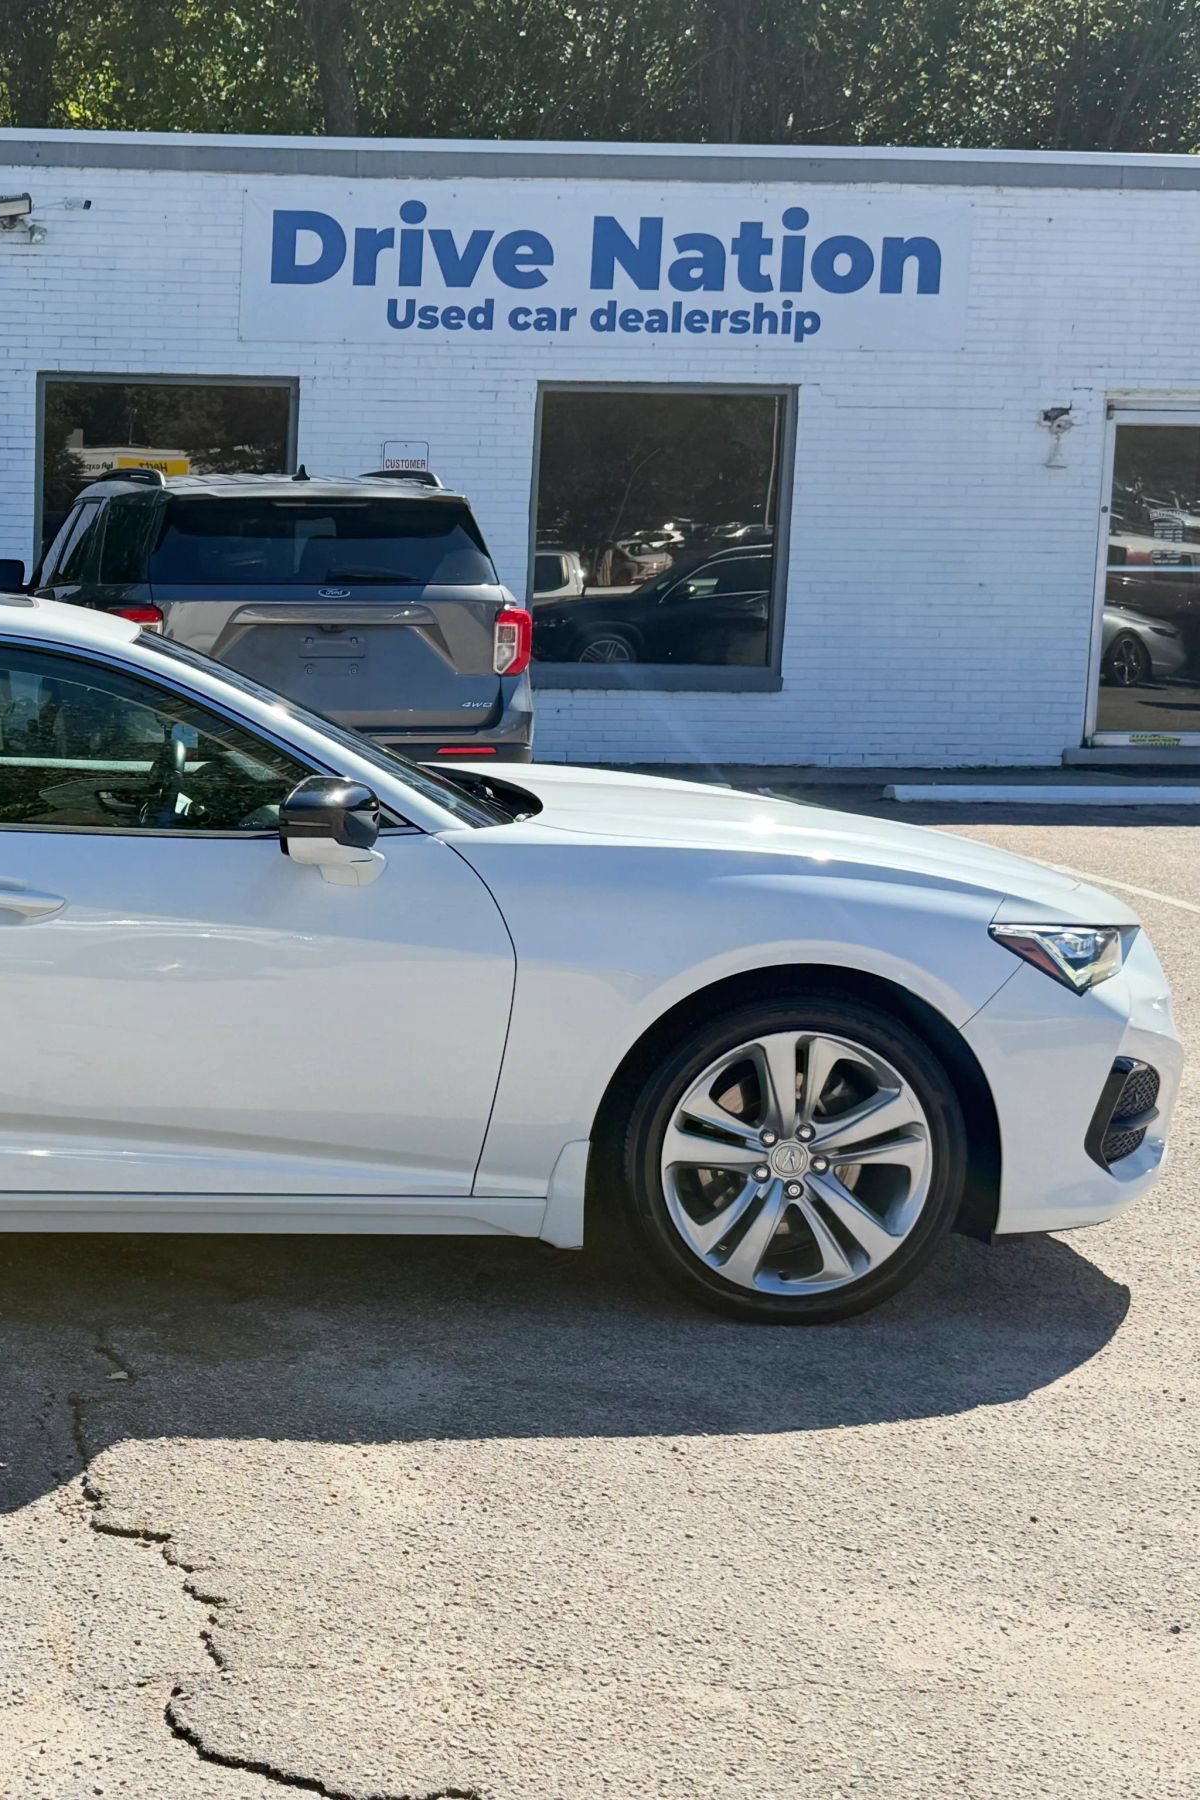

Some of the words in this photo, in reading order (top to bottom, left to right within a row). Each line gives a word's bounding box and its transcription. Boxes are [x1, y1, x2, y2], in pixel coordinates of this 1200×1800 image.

[270, 199, 555, 290] Drive
[589, 207, 942, 295] Nation
[386, 298, 495, 331] Used
[507, 306, 578, 332] car
[590, 300, 822, 344] dealership
[385, 459, 426, 469] CUSTOMER
